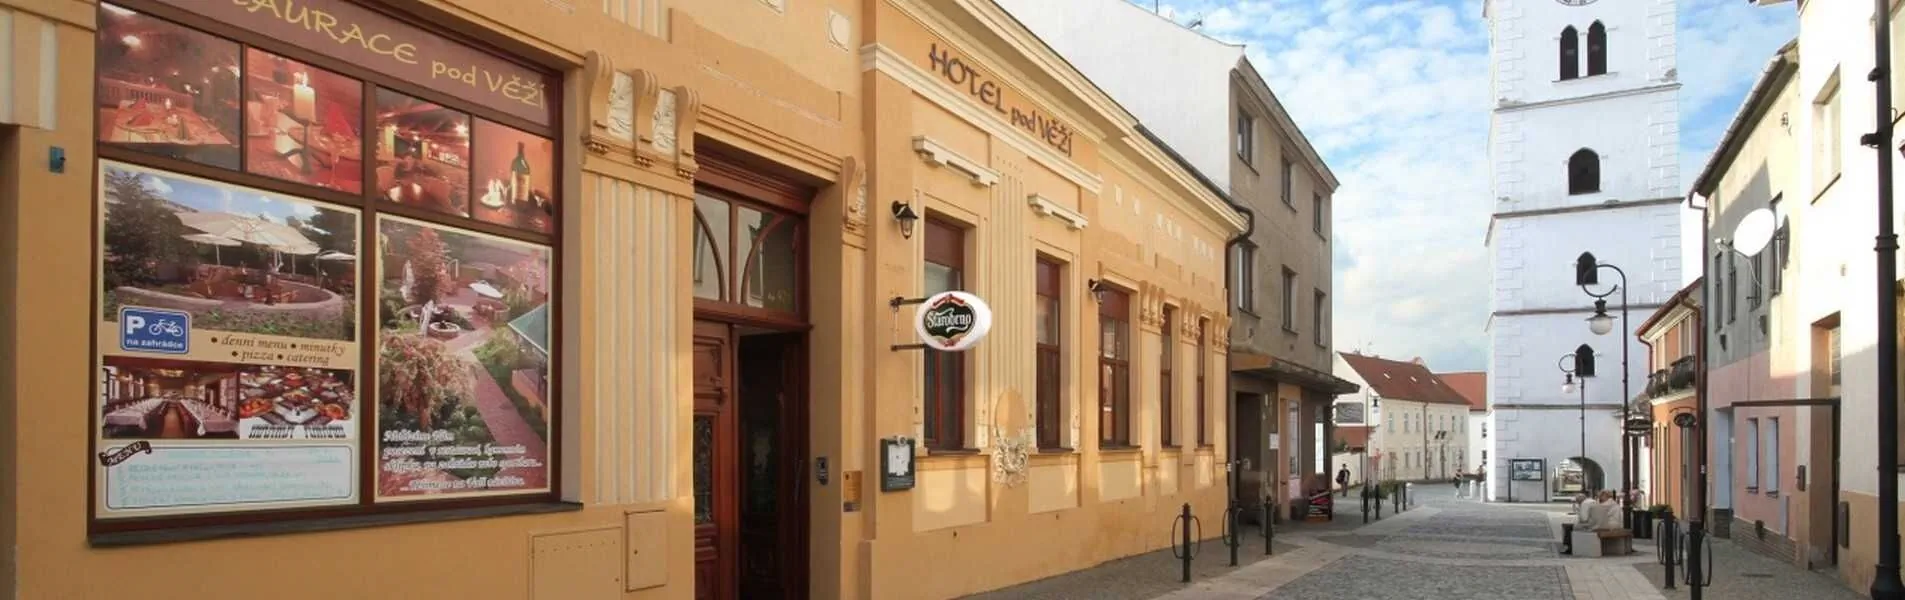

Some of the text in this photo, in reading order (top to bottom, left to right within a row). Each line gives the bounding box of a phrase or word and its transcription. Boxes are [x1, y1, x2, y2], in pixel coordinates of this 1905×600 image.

[232, 0, 545, 109] AURACE pod VĚŽÍ
[929, 43, 1073, 157] HOTEL pod VĚŽÍ
[126, 315, 145, 334] P
[258, 339, 287, 349] menu
[300, 342, 345, 356] minutky
[241, 351, 329, 366] pizza catering
